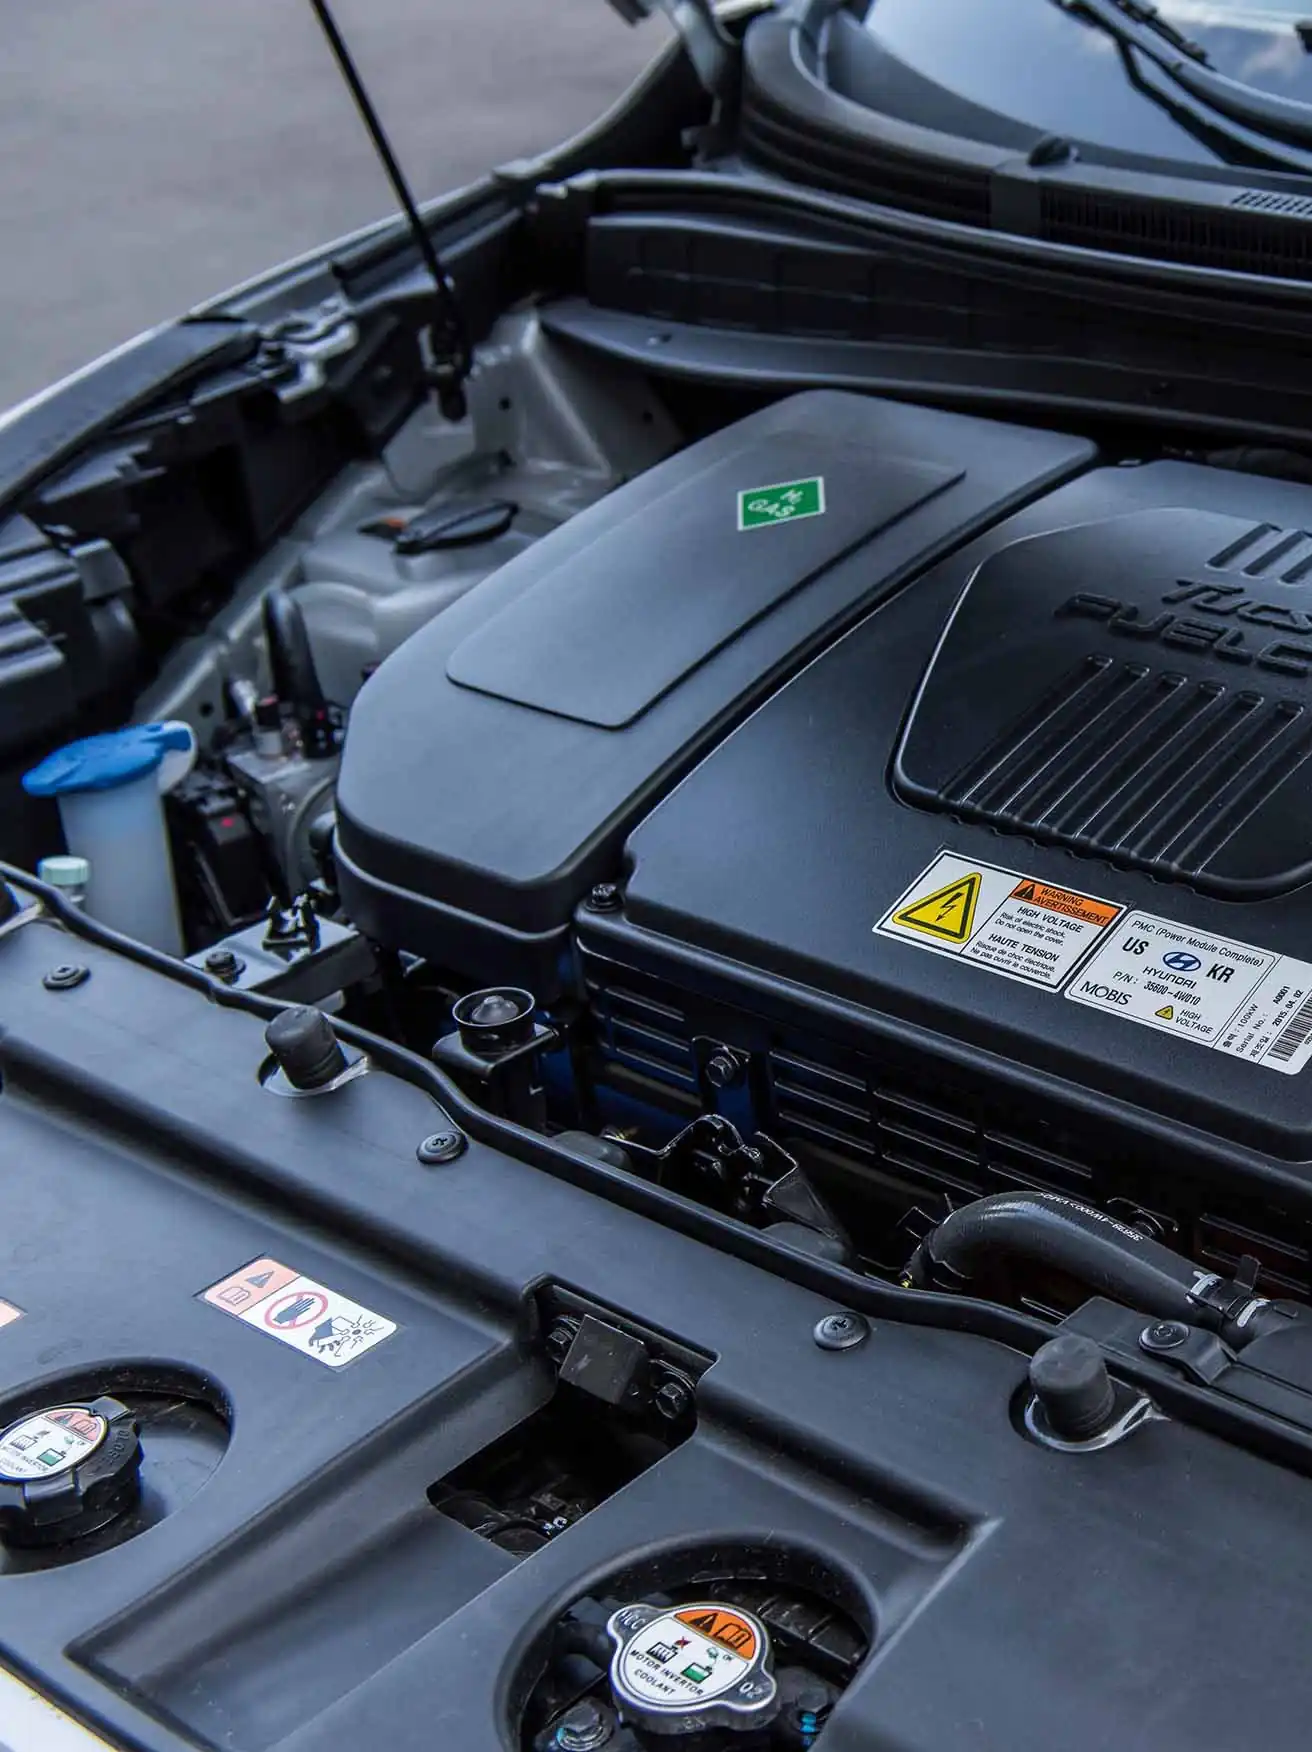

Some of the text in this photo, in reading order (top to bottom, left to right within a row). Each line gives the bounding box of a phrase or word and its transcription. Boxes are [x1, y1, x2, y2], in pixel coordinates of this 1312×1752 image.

[1040, 887, 1084, 906] WARNING
[1017, 906, 1084, 933] HIGH VOLTAGE
[1034, 896, 1109, 924] AVERTISSEMENT
[1000, 912, 1014, 922] Risk
[1014, 916, 1022, 924] of
[1022, 918, 1045, 931] electric
[1004, 922, 1017, 930] not
[1016, 926, 1033, 936] open
[1033, 930, 1044, 939] the
[970, 947, 980, 956] Ne
[980, 951, 993, 960] pas
[975, 941, 998, 954] Risque
[998, 948, 1007, 956] de
[1007, 951, 1024, 961] choc
[988, 933, 1060, 962] HAUTE TENSION
[1122, 936, 1149, 956] US
[1131, 920, 1265, 968] PMC (Power Module Complete)
[1142, 966, 1198, 990] HYUNDAI
[1206, 963, 1235, 984] KR
[1079, 981, 1133, 1006] MOBIS
[1143, 981, 1201, 1006] 35600-4W010
[1175, 1016, 1214, 1035] VOLTAGE
[1179, 1009, 1202, 1021] HIGH
[1237, 1003, 1258, 1028] 100kW
[1236, 1032, 1255, 1053] Serial
[630, 1649, 704, 1695] MOTOR INVERTOR
[634, 1669, 677, 1696] COOLANT
